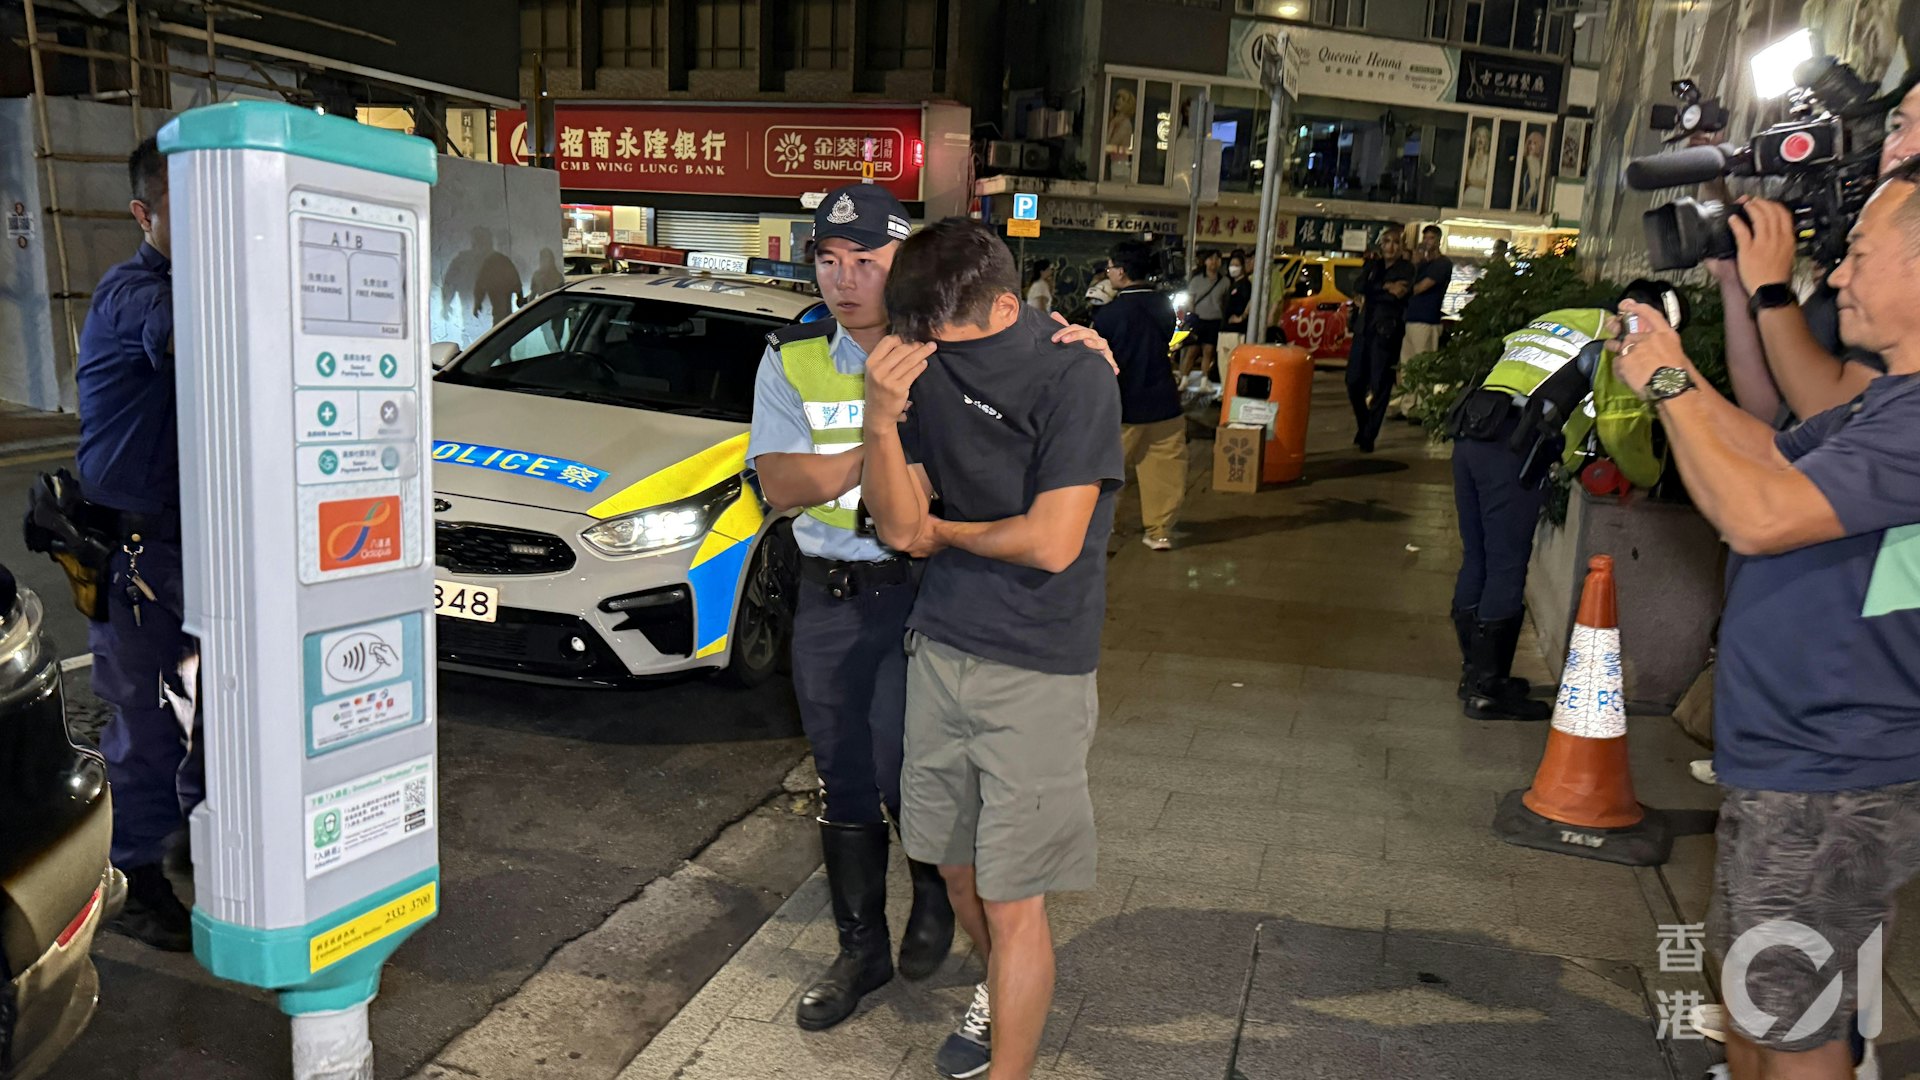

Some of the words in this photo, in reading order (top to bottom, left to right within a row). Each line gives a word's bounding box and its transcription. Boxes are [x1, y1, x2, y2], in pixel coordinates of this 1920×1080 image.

[1318, 45, 1361, 66] Queenie
[1366, 50, 1403, 71] Henna
[559, 125, 727, 162] 招商永隆銀行
[560, 160, 591, 172] CMB
[596, 161, 634, 173] WING
[639, 163, 679, 174] LUNG
[685, 164, 726, 176] BANK
[813, 159, 893, 173] SUNFLOER
[1018, 196, 1034, 217] P
[1106, 218, 1179, 233] EXCHANGE
[331, 231, 339, 248] A
[355, 235, 363, 249] B
[703, 256, 731, 271] POLICE
[557, 463, 600, 488] 察
[360, 548, 392, 560] Octopus
